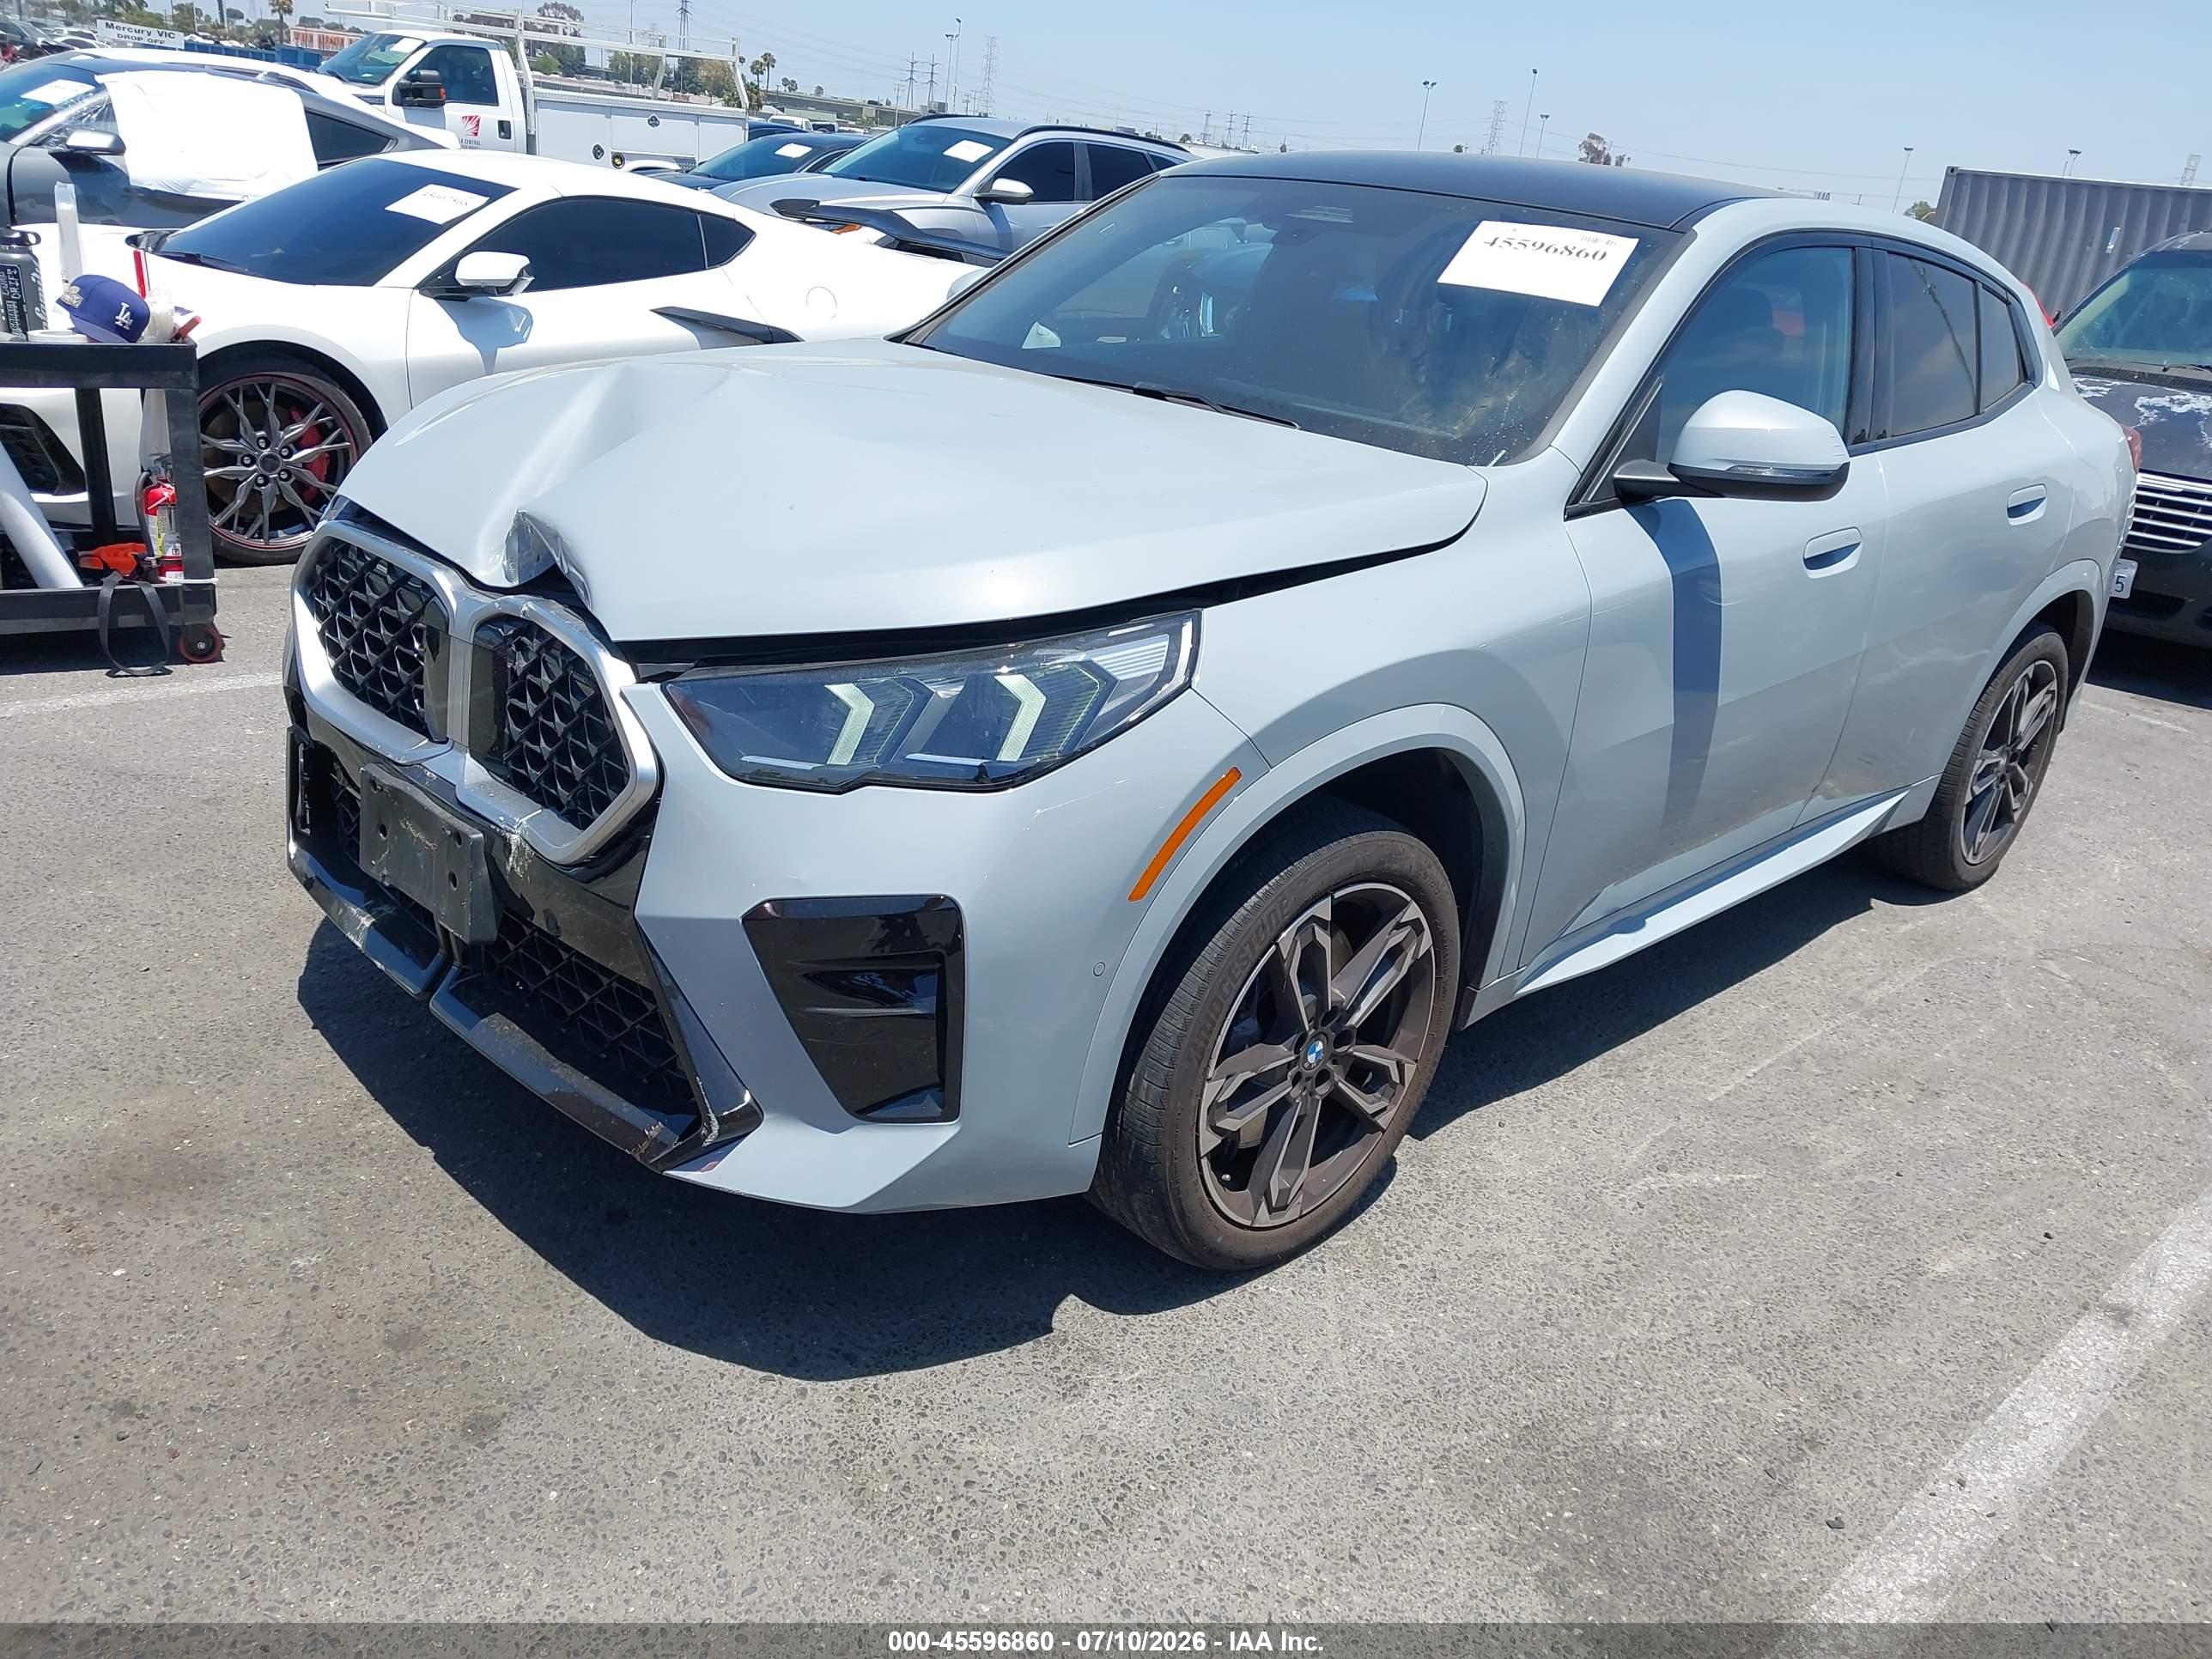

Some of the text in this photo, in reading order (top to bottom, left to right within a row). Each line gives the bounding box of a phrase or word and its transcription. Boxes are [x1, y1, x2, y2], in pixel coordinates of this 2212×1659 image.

[105, 21, 176, 40] Mercury VIC
[1484, 236, 1607, 261] 45596860
[6, 268, 21, 300] DRIFT
[115, 302, 134, 331] LA
